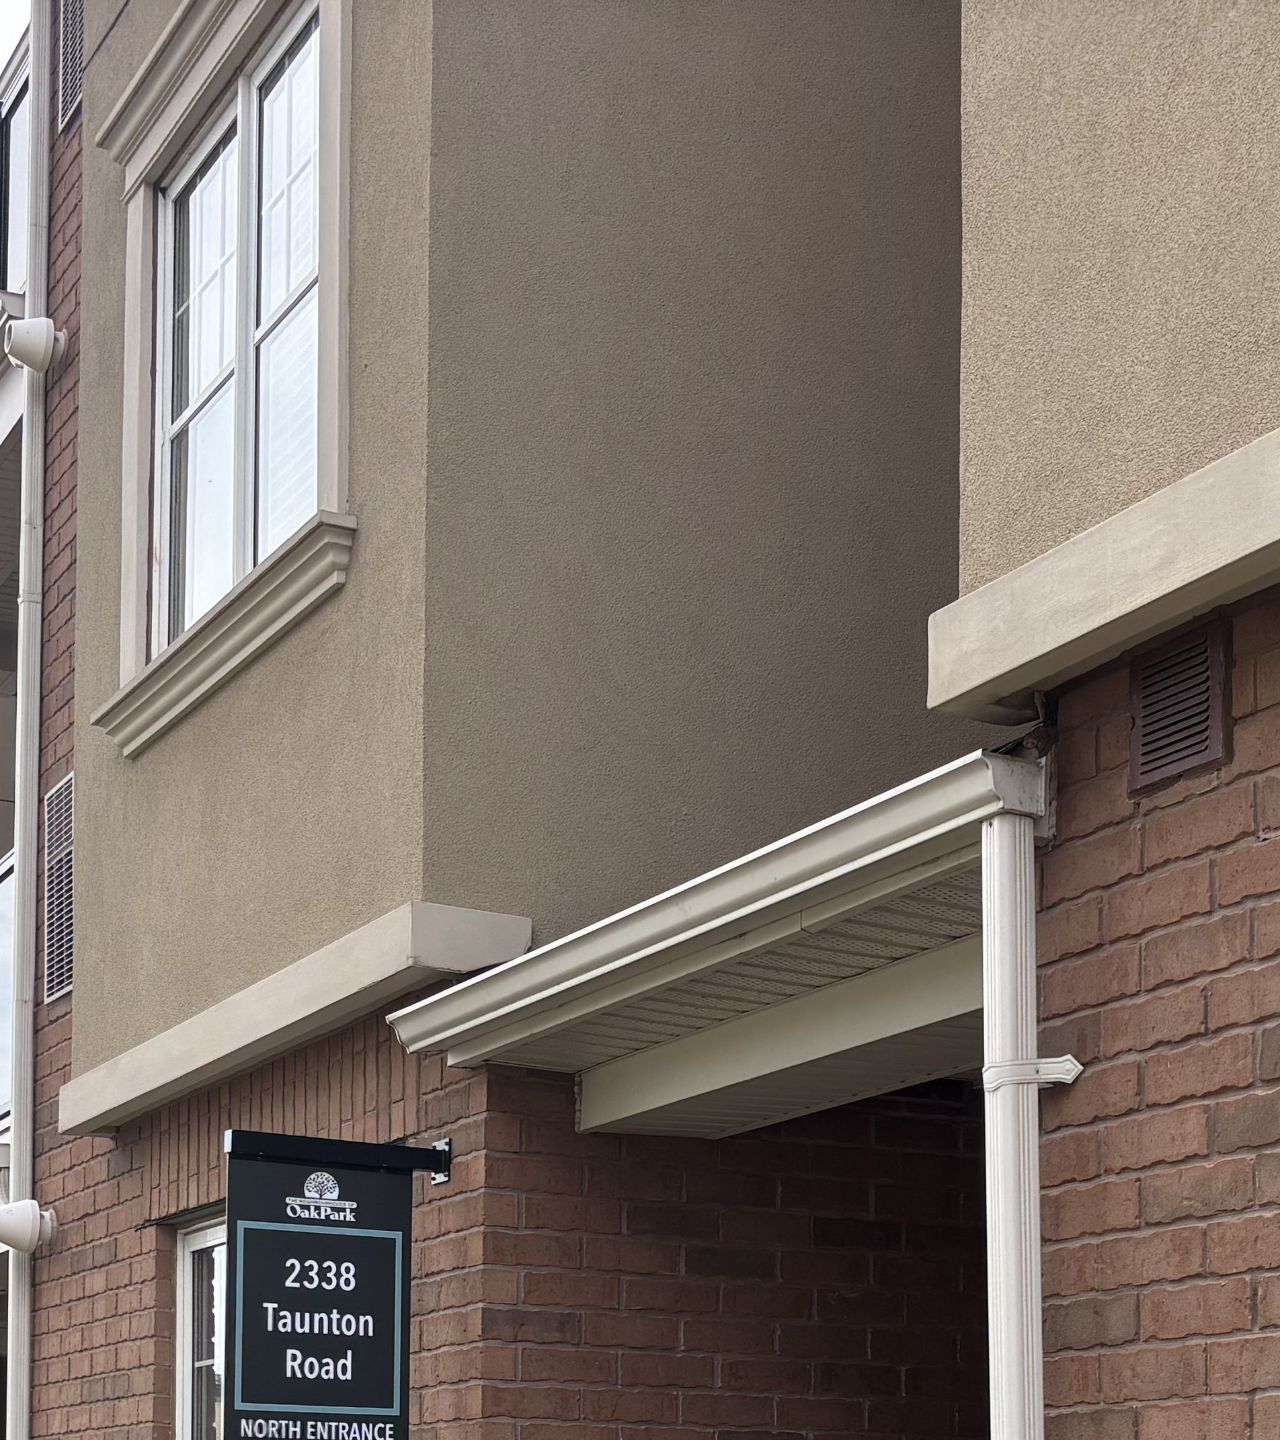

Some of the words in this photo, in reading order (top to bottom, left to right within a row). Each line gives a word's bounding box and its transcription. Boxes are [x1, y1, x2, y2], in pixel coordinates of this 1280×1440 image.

[284, 1258, 356, 1292] 2338
[262, 1302, 374, 1337] Taunton
[285, 1349, 353, 1381] Road
[240, 1418, 300, 1440] NORTH
